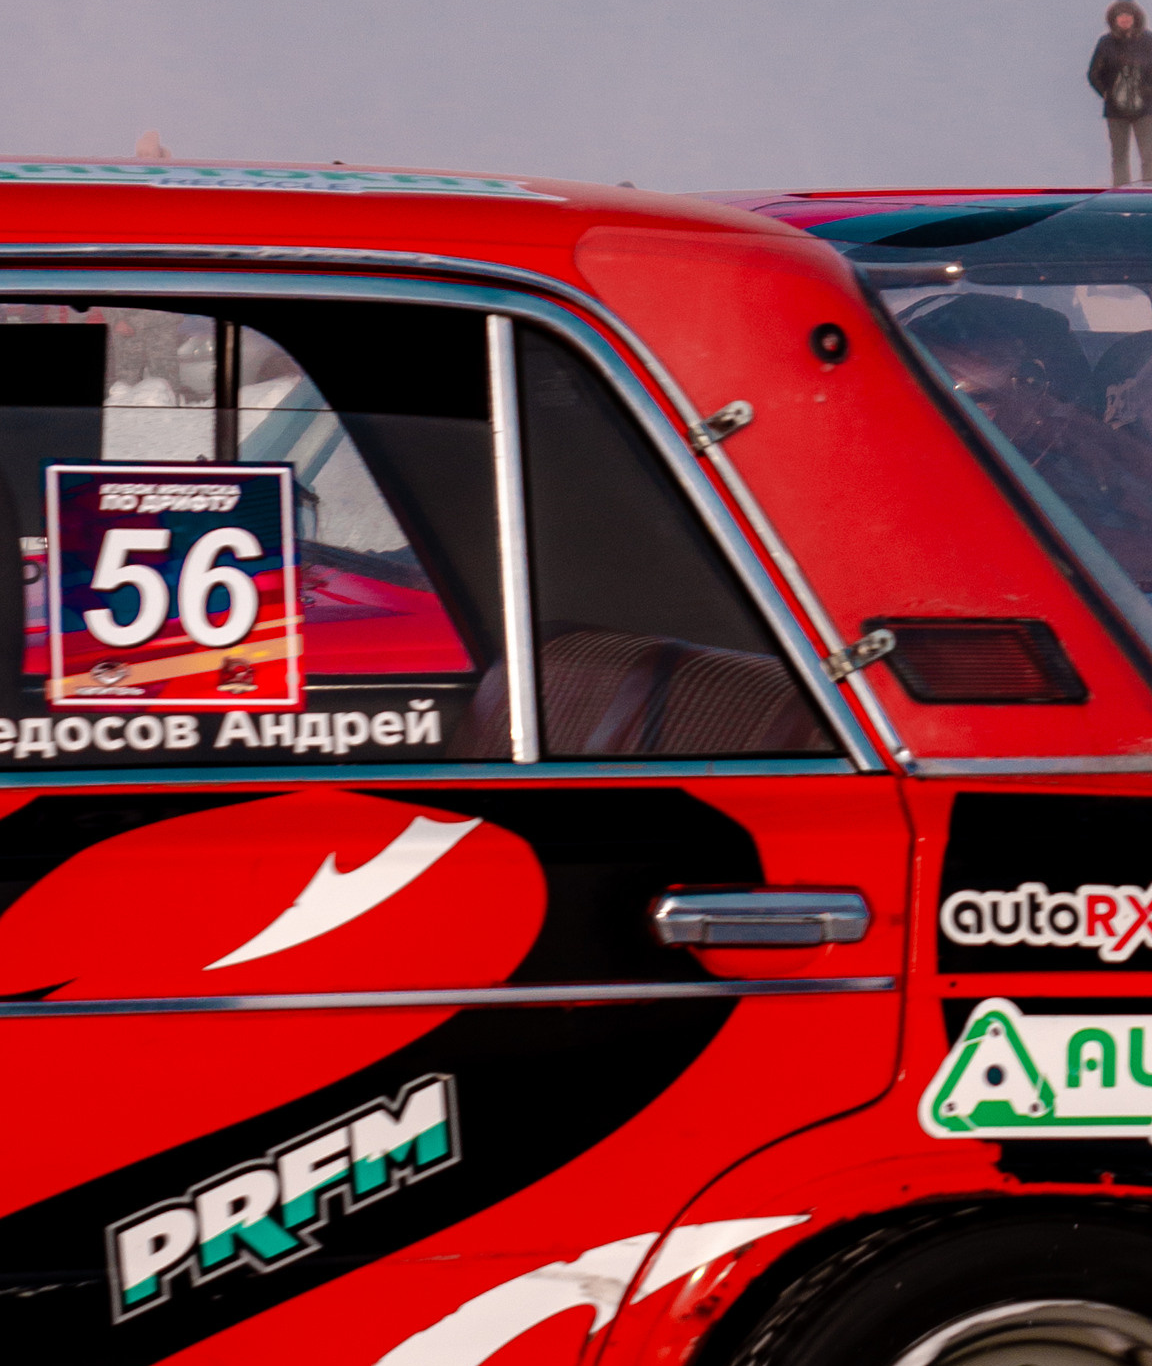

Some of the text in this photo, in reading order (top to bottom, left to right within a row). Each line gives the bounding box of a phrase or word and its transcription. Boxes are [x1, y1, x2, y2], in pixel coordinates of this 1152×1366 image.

[83, 526, 263, 648] 56
[213, 698, 441, 755] Андрей
[116, 1078, 452, 1307] PRFM
